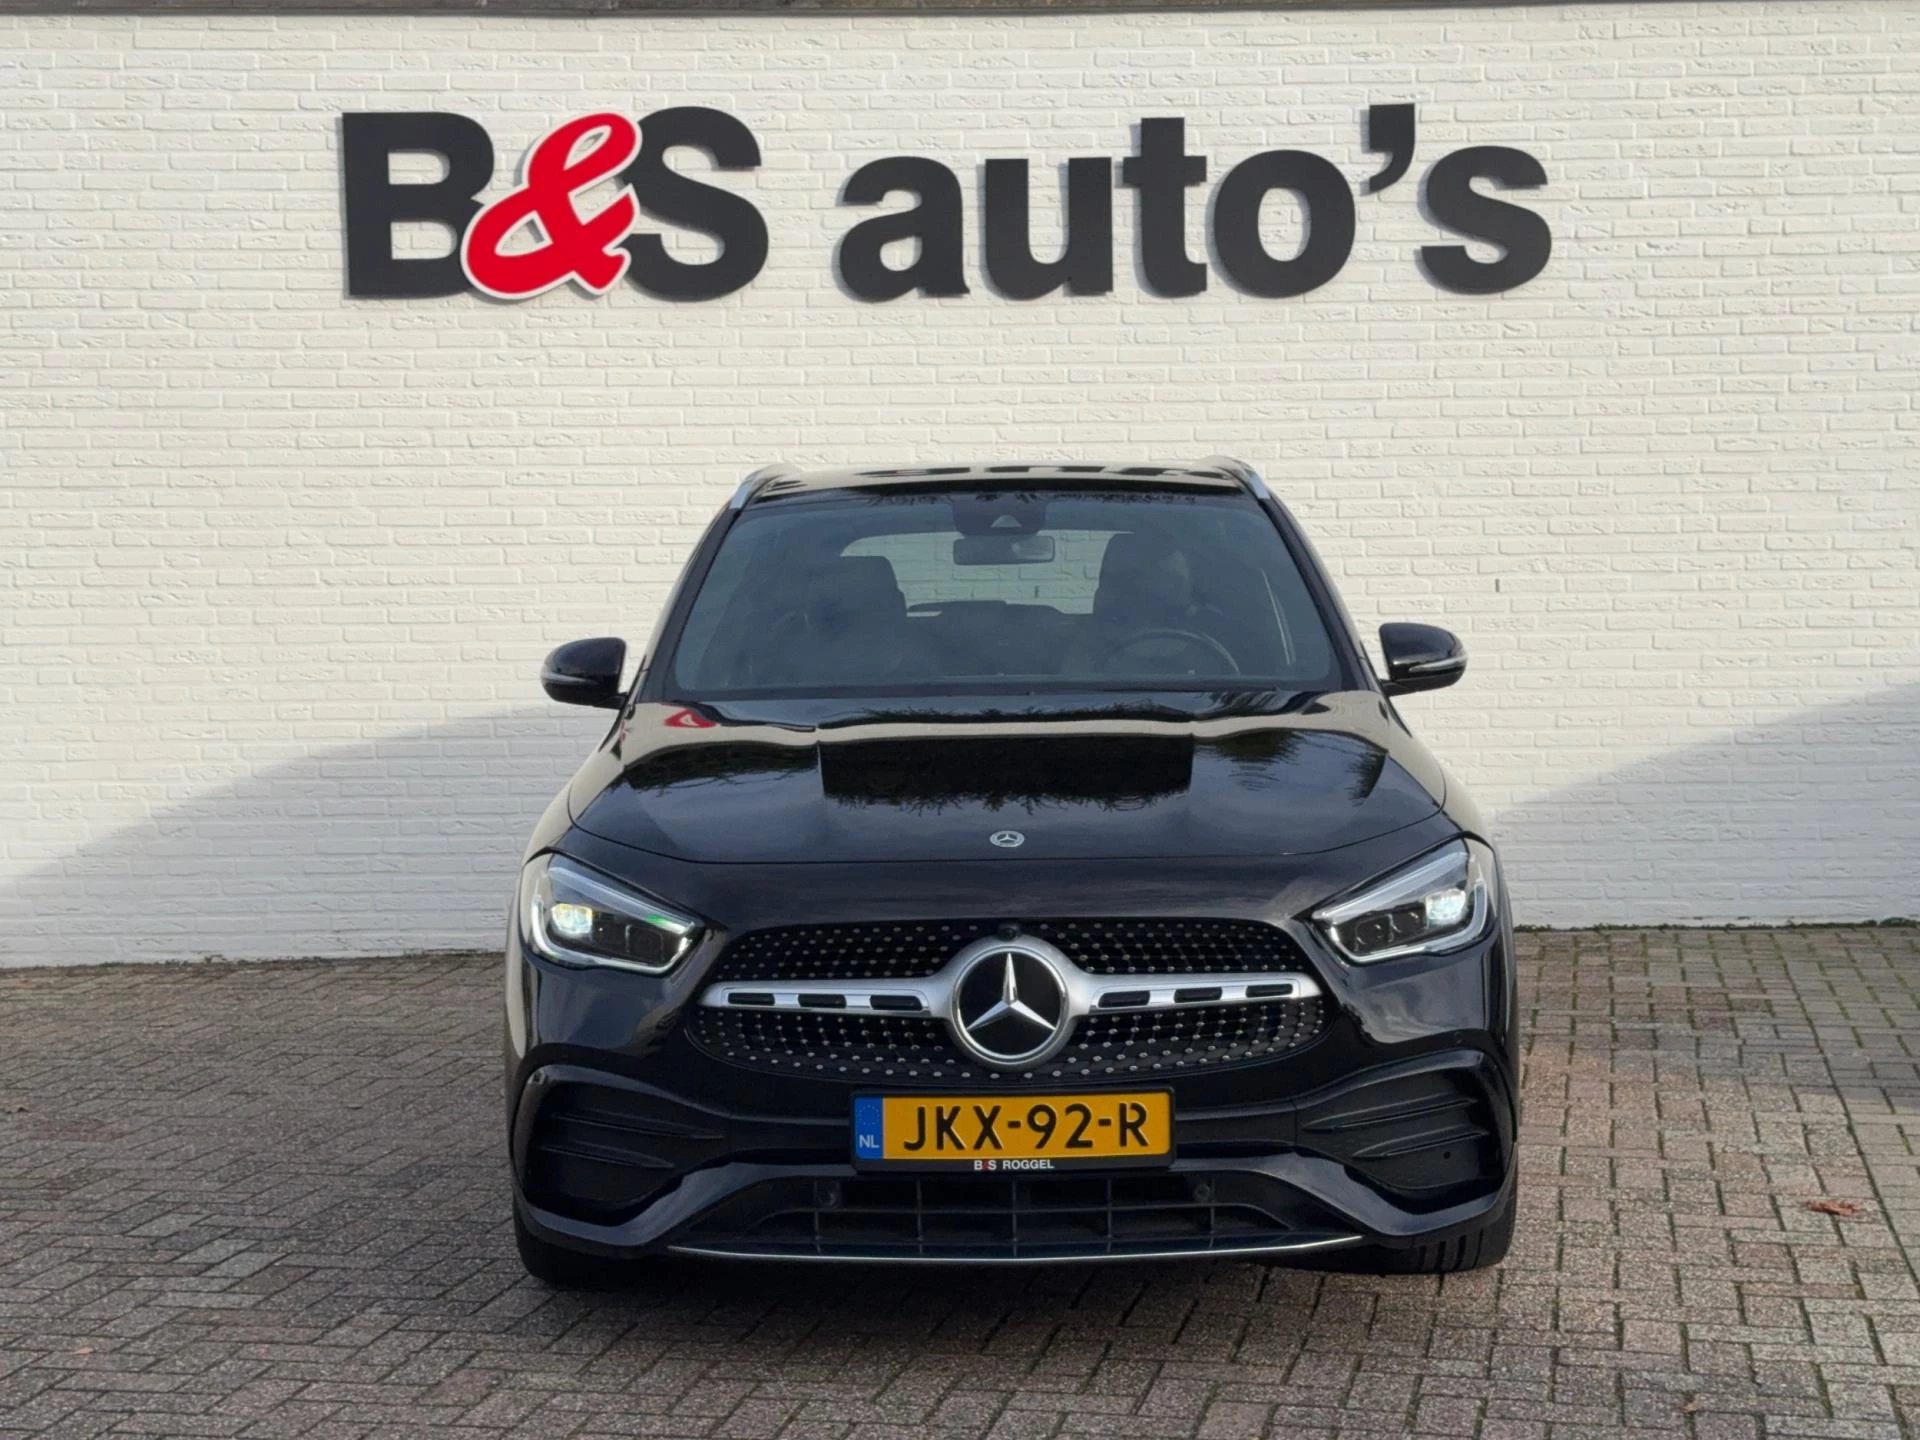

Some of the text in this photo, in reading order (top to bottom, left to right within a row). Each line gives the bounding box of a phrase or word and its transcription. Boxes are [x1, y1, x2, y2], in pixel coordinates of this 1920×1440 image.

[340, 104, 1552, 301] B&S auto's
[903, 1102, 1150, 1150] JKX-92-R
[859, 1135, 880, 1149] NL
[1002, 1158, 1055, 1170] ROGGEL
